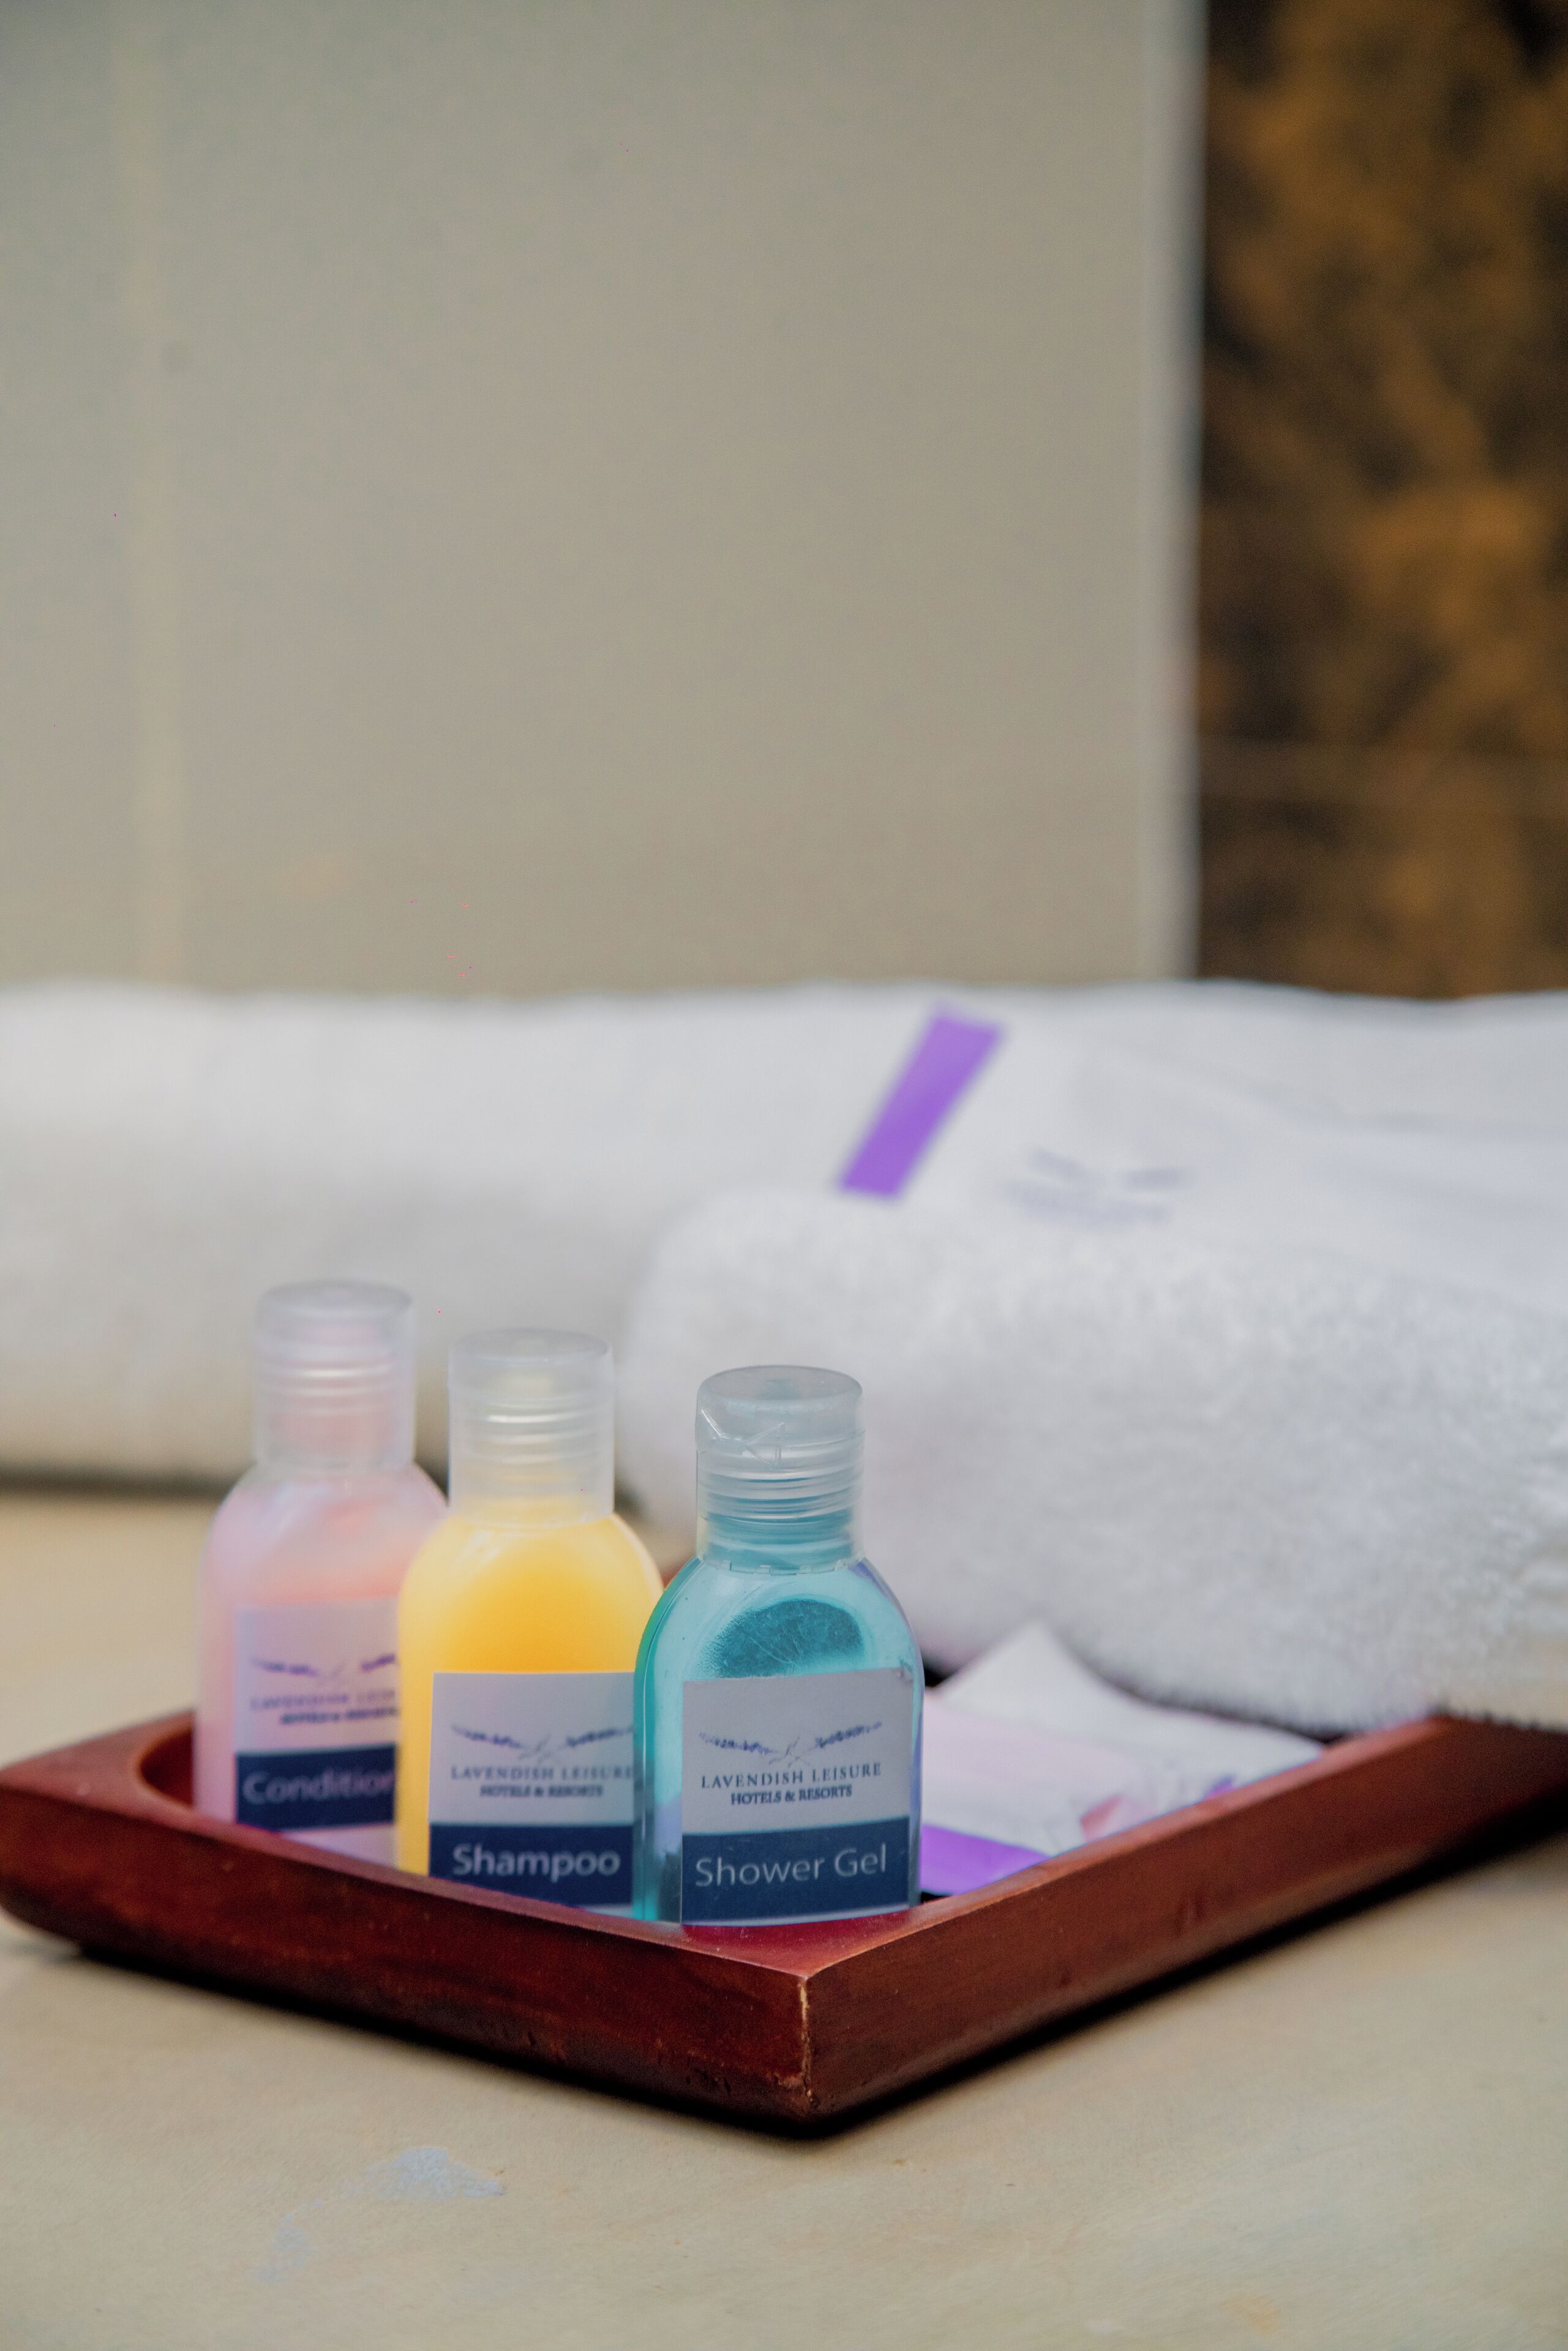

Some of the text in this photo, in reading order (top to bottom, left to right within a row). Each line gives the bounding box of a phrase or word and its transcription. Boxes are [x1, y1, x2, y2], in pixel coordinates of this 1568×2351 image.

[451, 1766, 553, 1780] LAVENDISH
[701, 1761, 882, 1789] LAVENDISH LEISURE
[730, 1784, 852, 1805] HOTELS & RESORTS
[452, 1842, 621, 1883] Shampoo
[695, 1842, 887, 1888] Shower Gel
